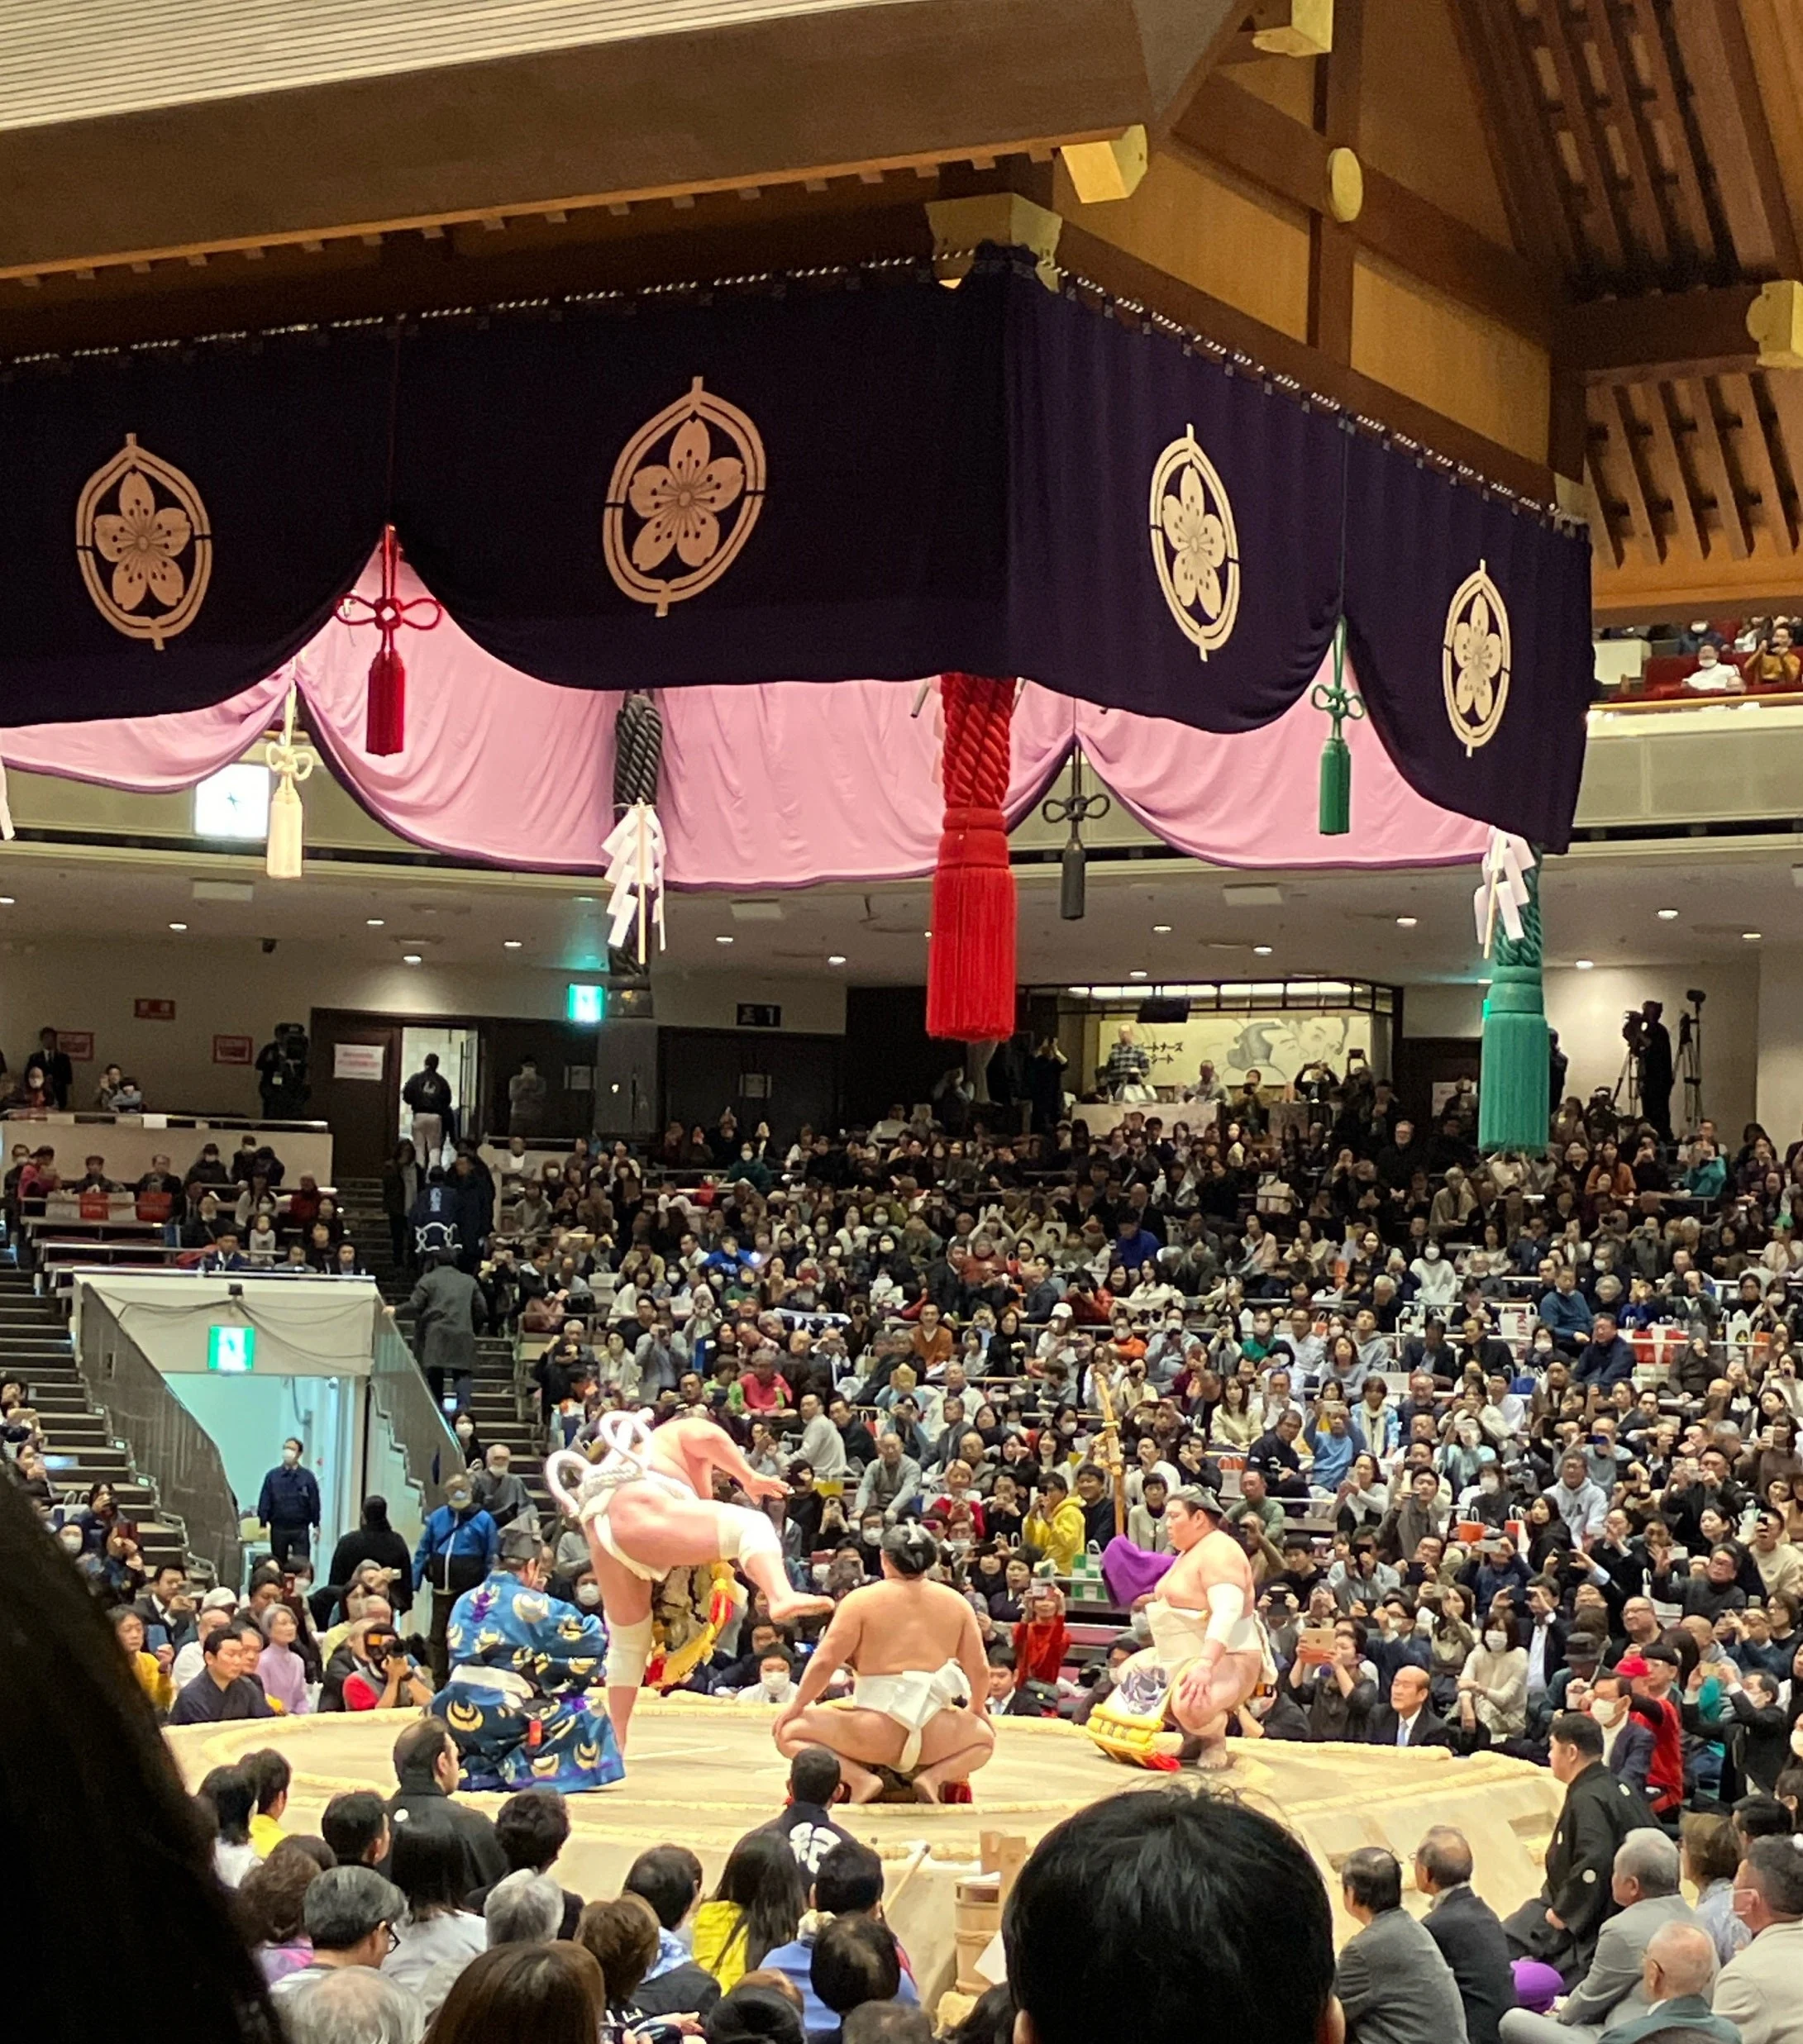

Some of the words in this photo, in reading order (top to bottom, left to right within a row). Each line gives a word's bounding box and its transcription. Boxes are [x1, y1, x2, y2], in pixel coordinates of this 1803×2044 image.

[1142, 1041, 1184, 1053] ートナーズ
